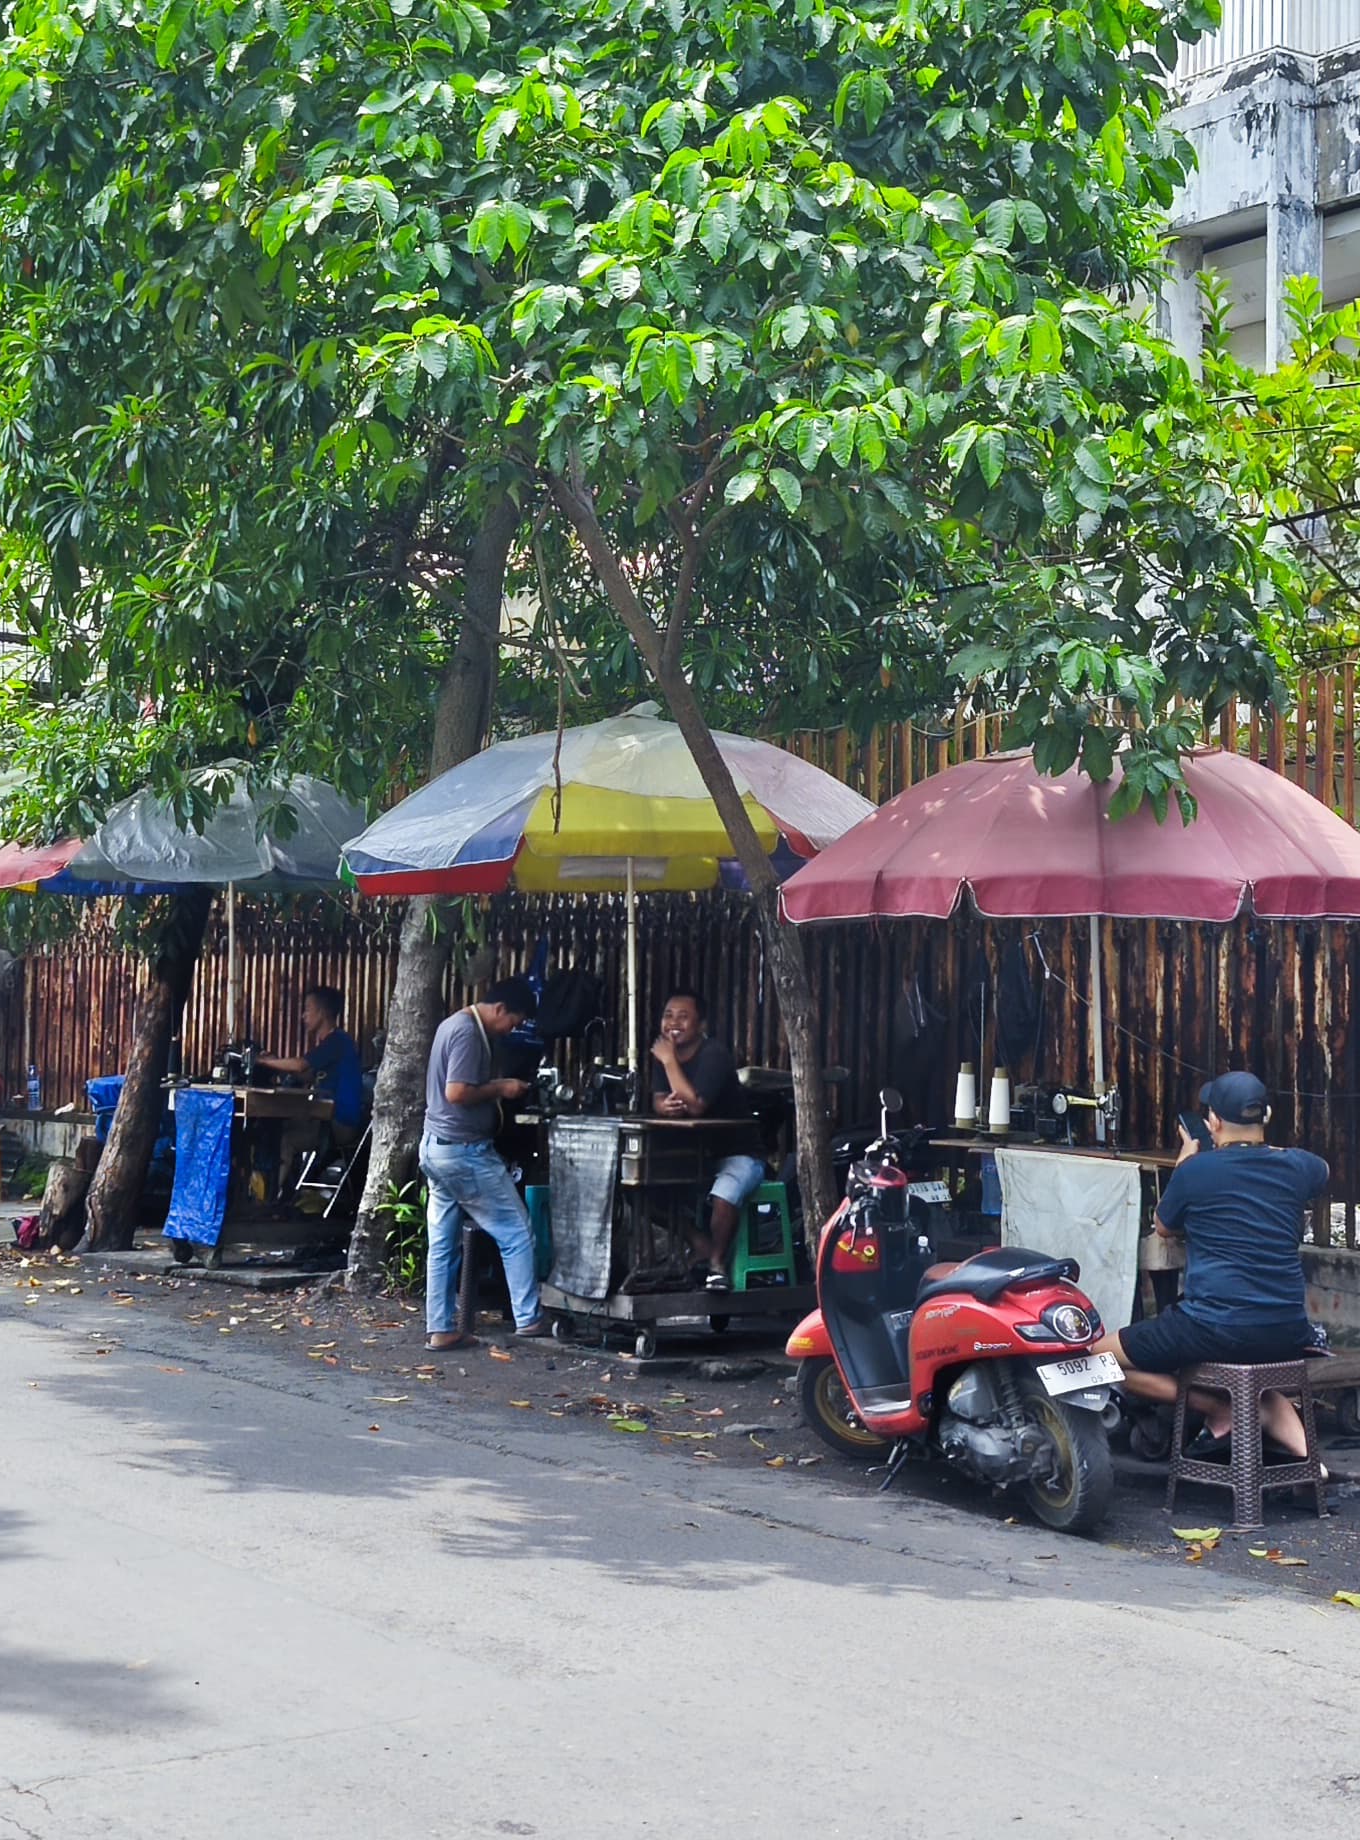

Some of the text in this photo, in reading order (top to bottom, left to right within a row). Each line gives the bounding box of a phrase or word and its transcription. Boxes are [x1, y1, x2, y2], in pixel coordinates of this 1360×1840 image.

[1039, 1352, 1117, 1381] L 5092 PJ
